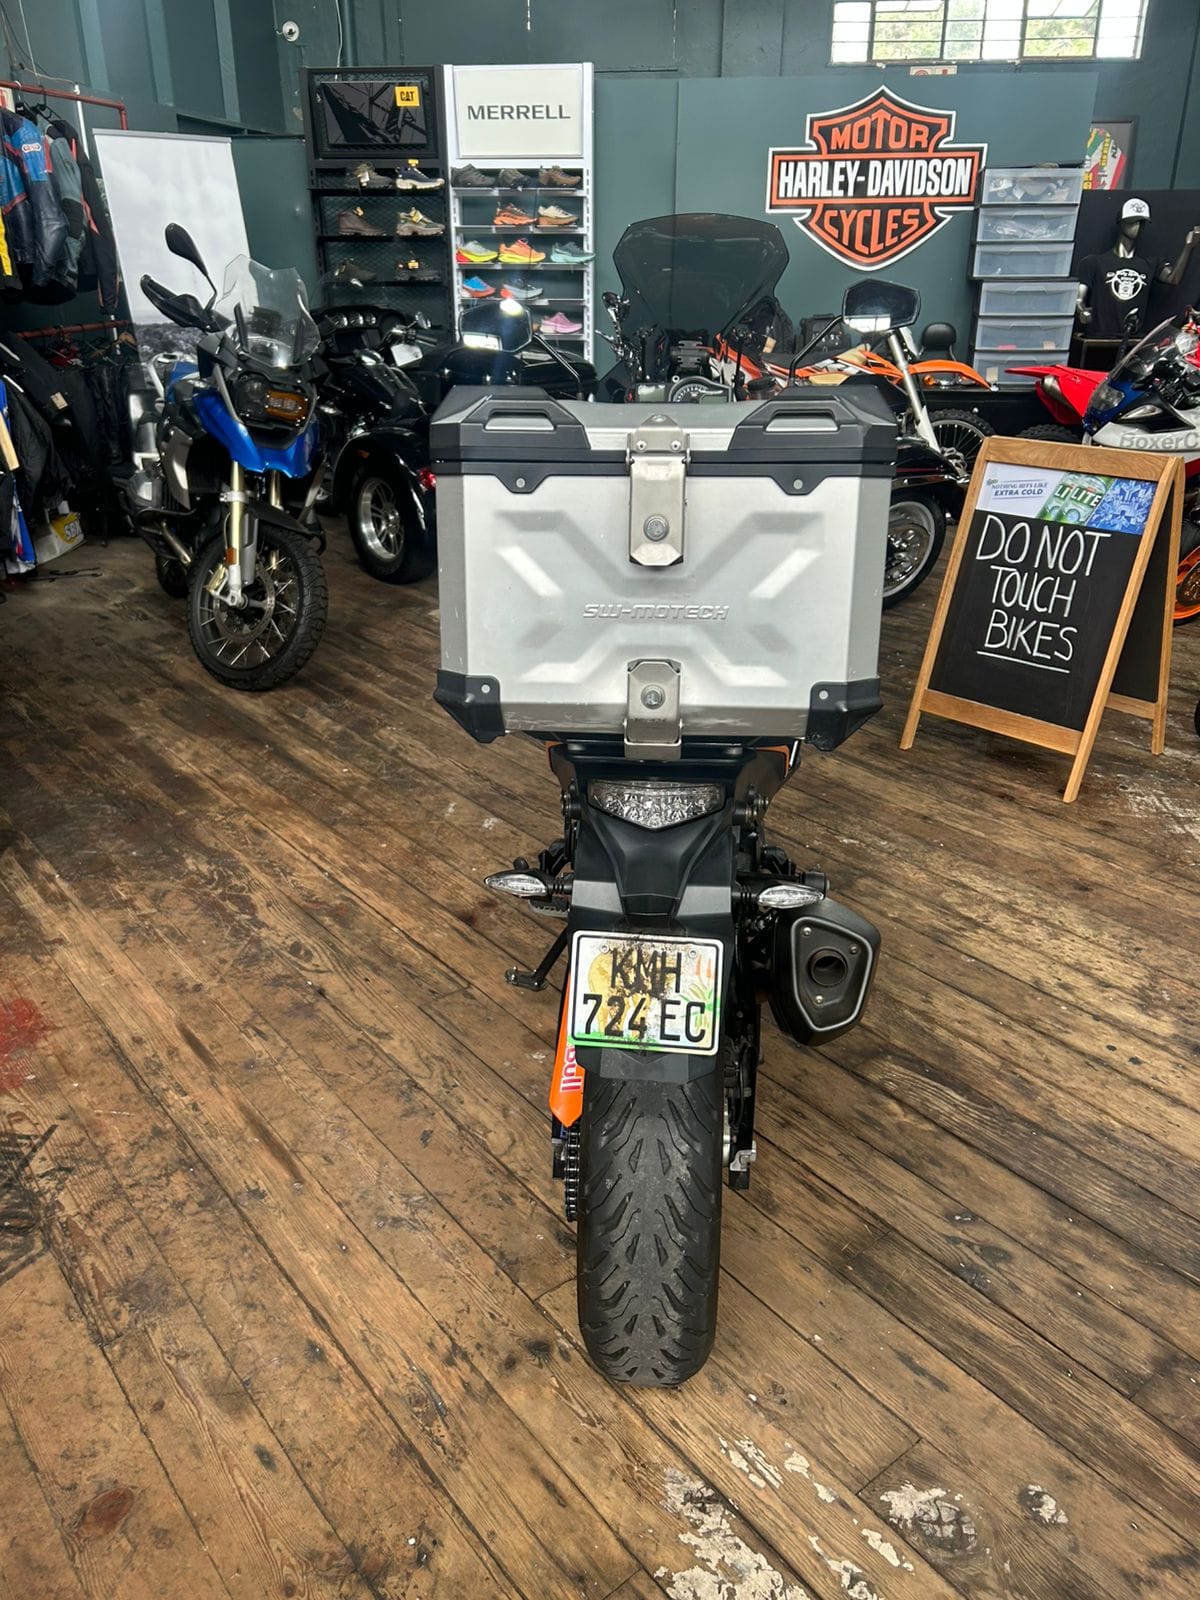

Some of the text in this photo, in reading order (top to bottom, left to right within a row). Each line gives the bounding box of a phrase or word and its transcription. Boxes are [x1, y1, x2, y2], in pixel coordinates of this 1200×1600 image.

[400, 91, 415, 102] CAT
[467, 104, 571, 120] MERRELL
[831, 108, 929, 150] MOTOR
[778, 158, 973, 198] HARLEY-DAVIDSON
[823, 208, 921, 255] CYCLES
[1021, 488, 1043, 496] COLD
[1071, 487, 1102, 507] LITE
[976, 514, 1112, 576] DO NOT
[583, 604, 730, 620] SW-MOTECH
[990, 565, 1077, 618] TOUCH
[984, 609, 1078, 661] BIKES
[610, 947, 683, 994] KMH
[583, 993, 706, 1043] 724 EC
